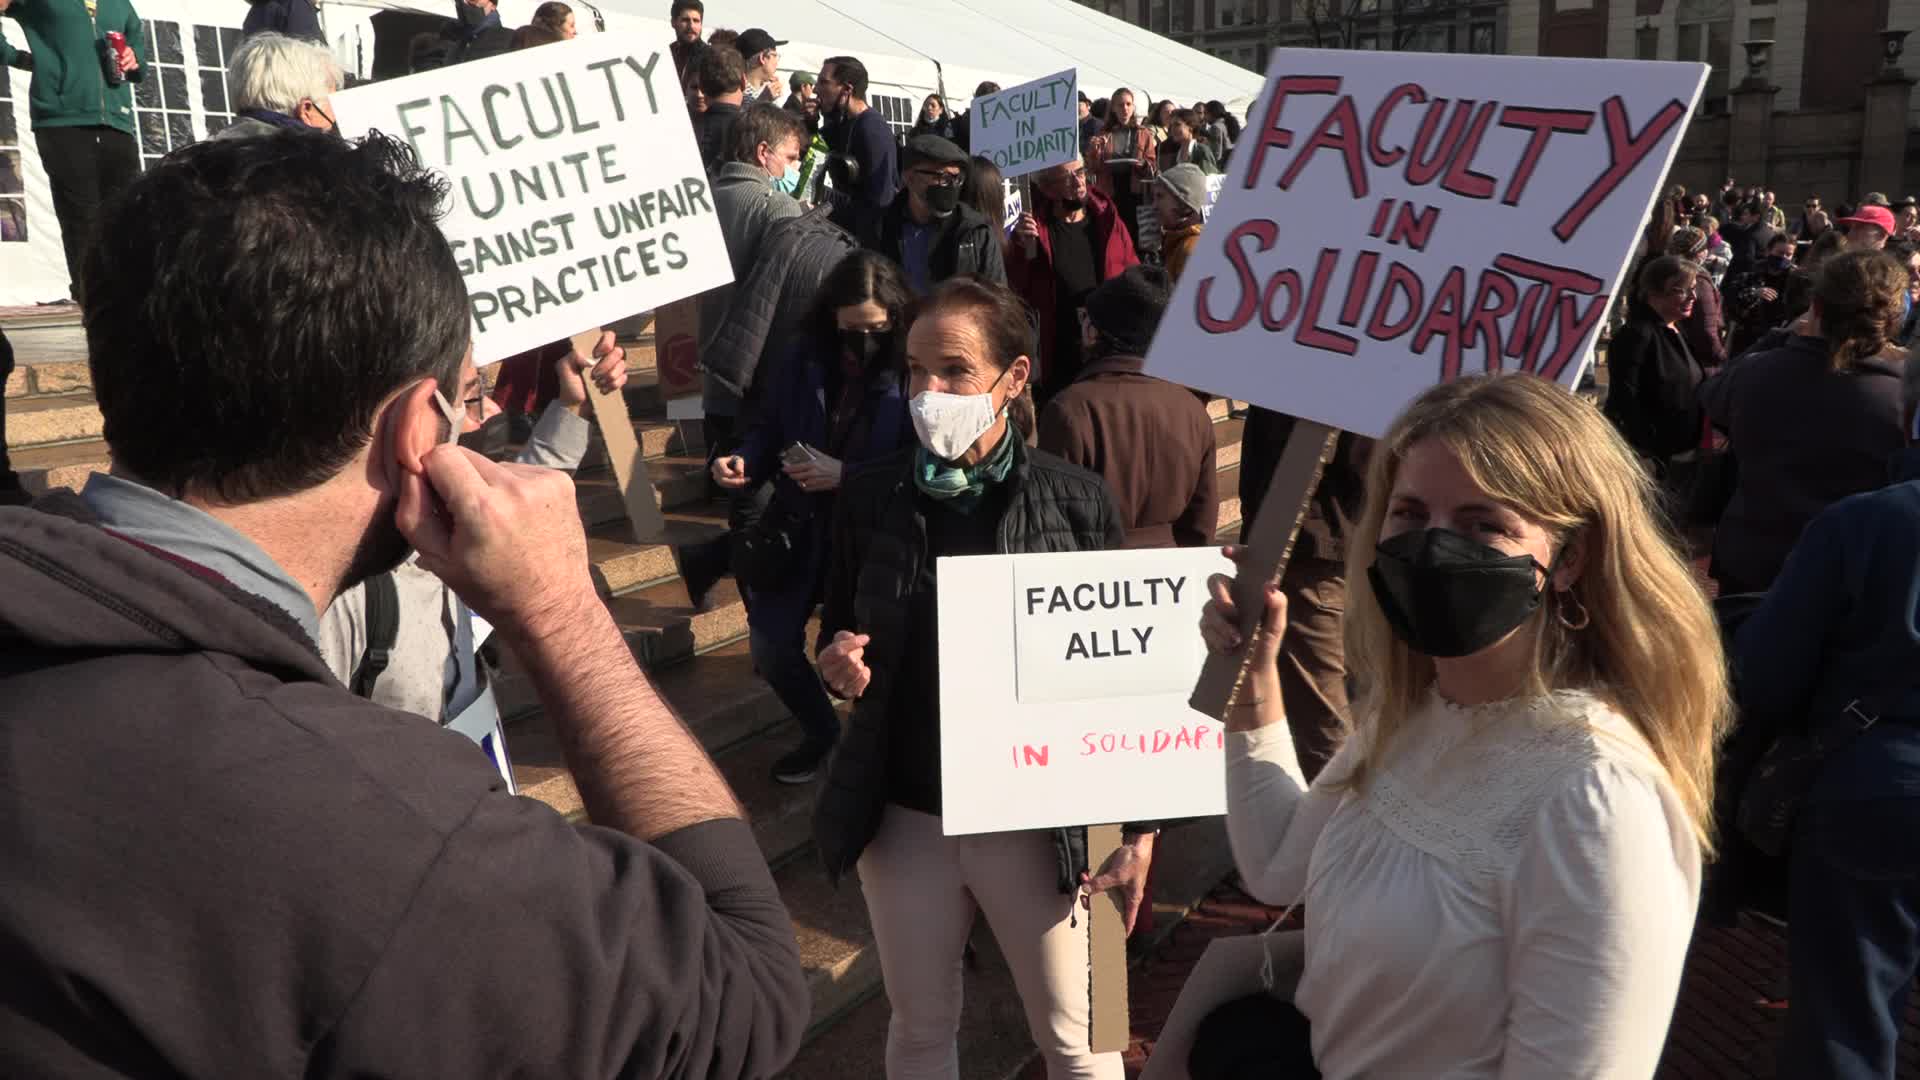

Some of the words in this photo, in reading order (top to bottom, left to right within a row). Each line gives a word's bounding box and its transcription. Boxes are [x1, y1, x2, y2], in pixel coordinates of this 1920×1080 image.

[396, 52, 661, 168] FACULTY
[979, 73, 1077, 129] FACULTY
[1015, 115, 1037, 138] IN
[461, 144, 627, 220] UNITE
[1243, 75, 1688, 244] FACULTY
[449, 212, 575, 276] GAINST
[593, 177, 713, 240] UNFAIR
[1368, 198, 1442, 252] IN
[468, 232, 689, 333] PRACTICES
[1197, 219, 1611, 382] SOLIDARITY
[1026, 576, 1187, 615] FACULTY
[1065, 626, 1154, 660] ALLY
[1012, 744, 1049, 768] IN
[1080, 725, 1223, 756] SOLIDARI
